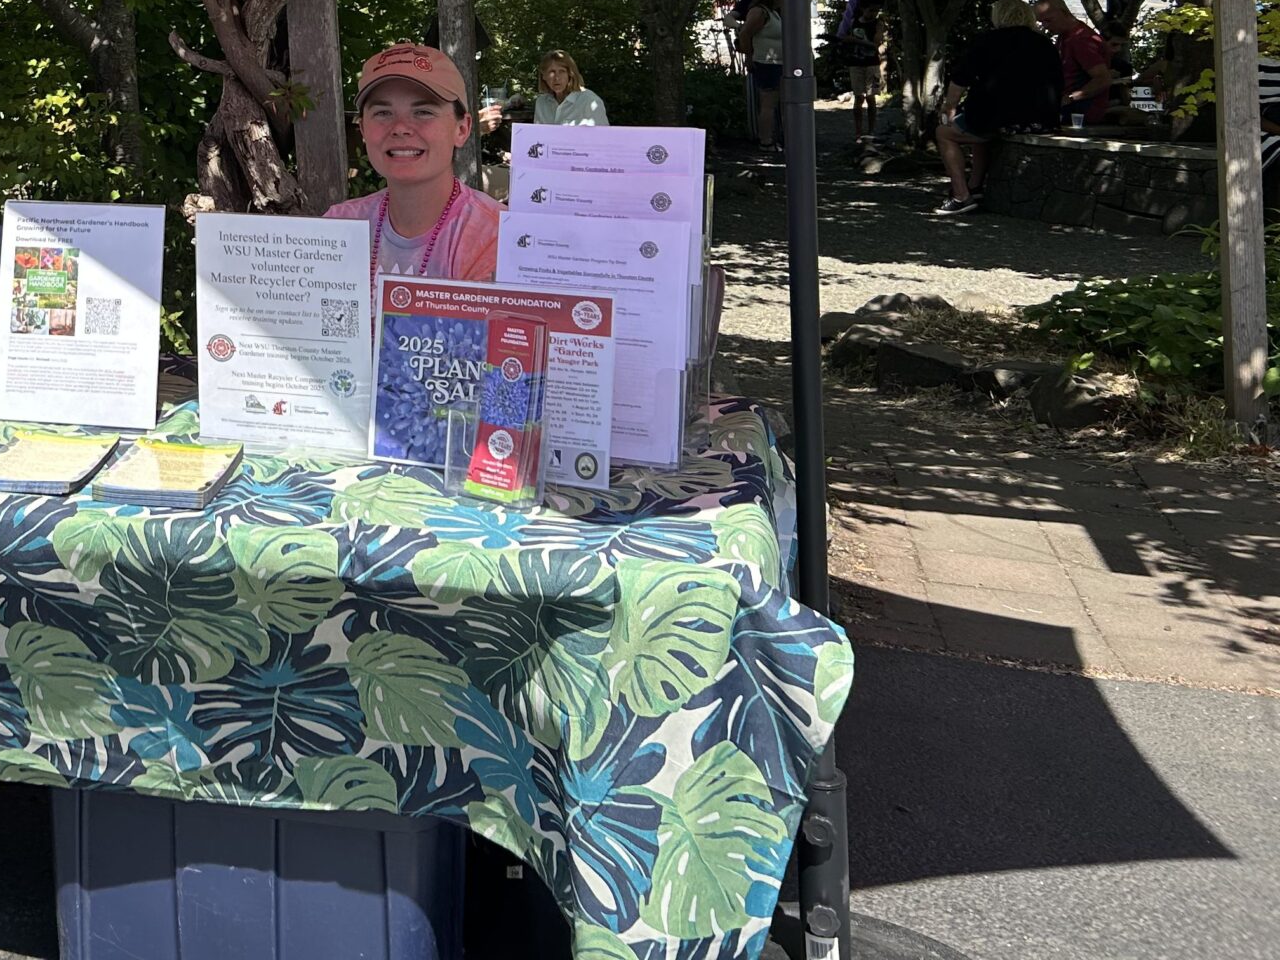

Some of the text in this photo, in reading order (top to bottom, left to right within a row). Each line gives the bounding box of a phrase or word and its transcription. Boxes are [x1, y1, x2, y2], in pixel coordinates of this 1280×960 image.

[16, 225, 45, 233] Growing
[17, 216, 40, 224] Pacific
[114, 220, 149, 228] Handbook
[219, 231, 269, 244] Interested
[272, 233, 282, 244] in
[285, 234, 338, 249] becoming
[224, 245, 343, 262] WSU Master Gardener
[251, 261, 315, 274] volunteer or
[211, 272, 358, 292] Master Recycler Composter
[255, 289, 311, 302] volunteer?
[415, 289, 561, 310] MASTER GARDENER FOUNDATION
[415, 300, 490, 315] of Thurston County
[398, 335, 444, 355] 2025
[549, 336, 605, 349] Dirt Works
[321, 347, 342, 355] Master
[554, 347, 594, 358] Garden
[310, 354, 334, 363] October
[410, 356, 488, 382] PLAN
[425, 380, 477, 405] SAL
